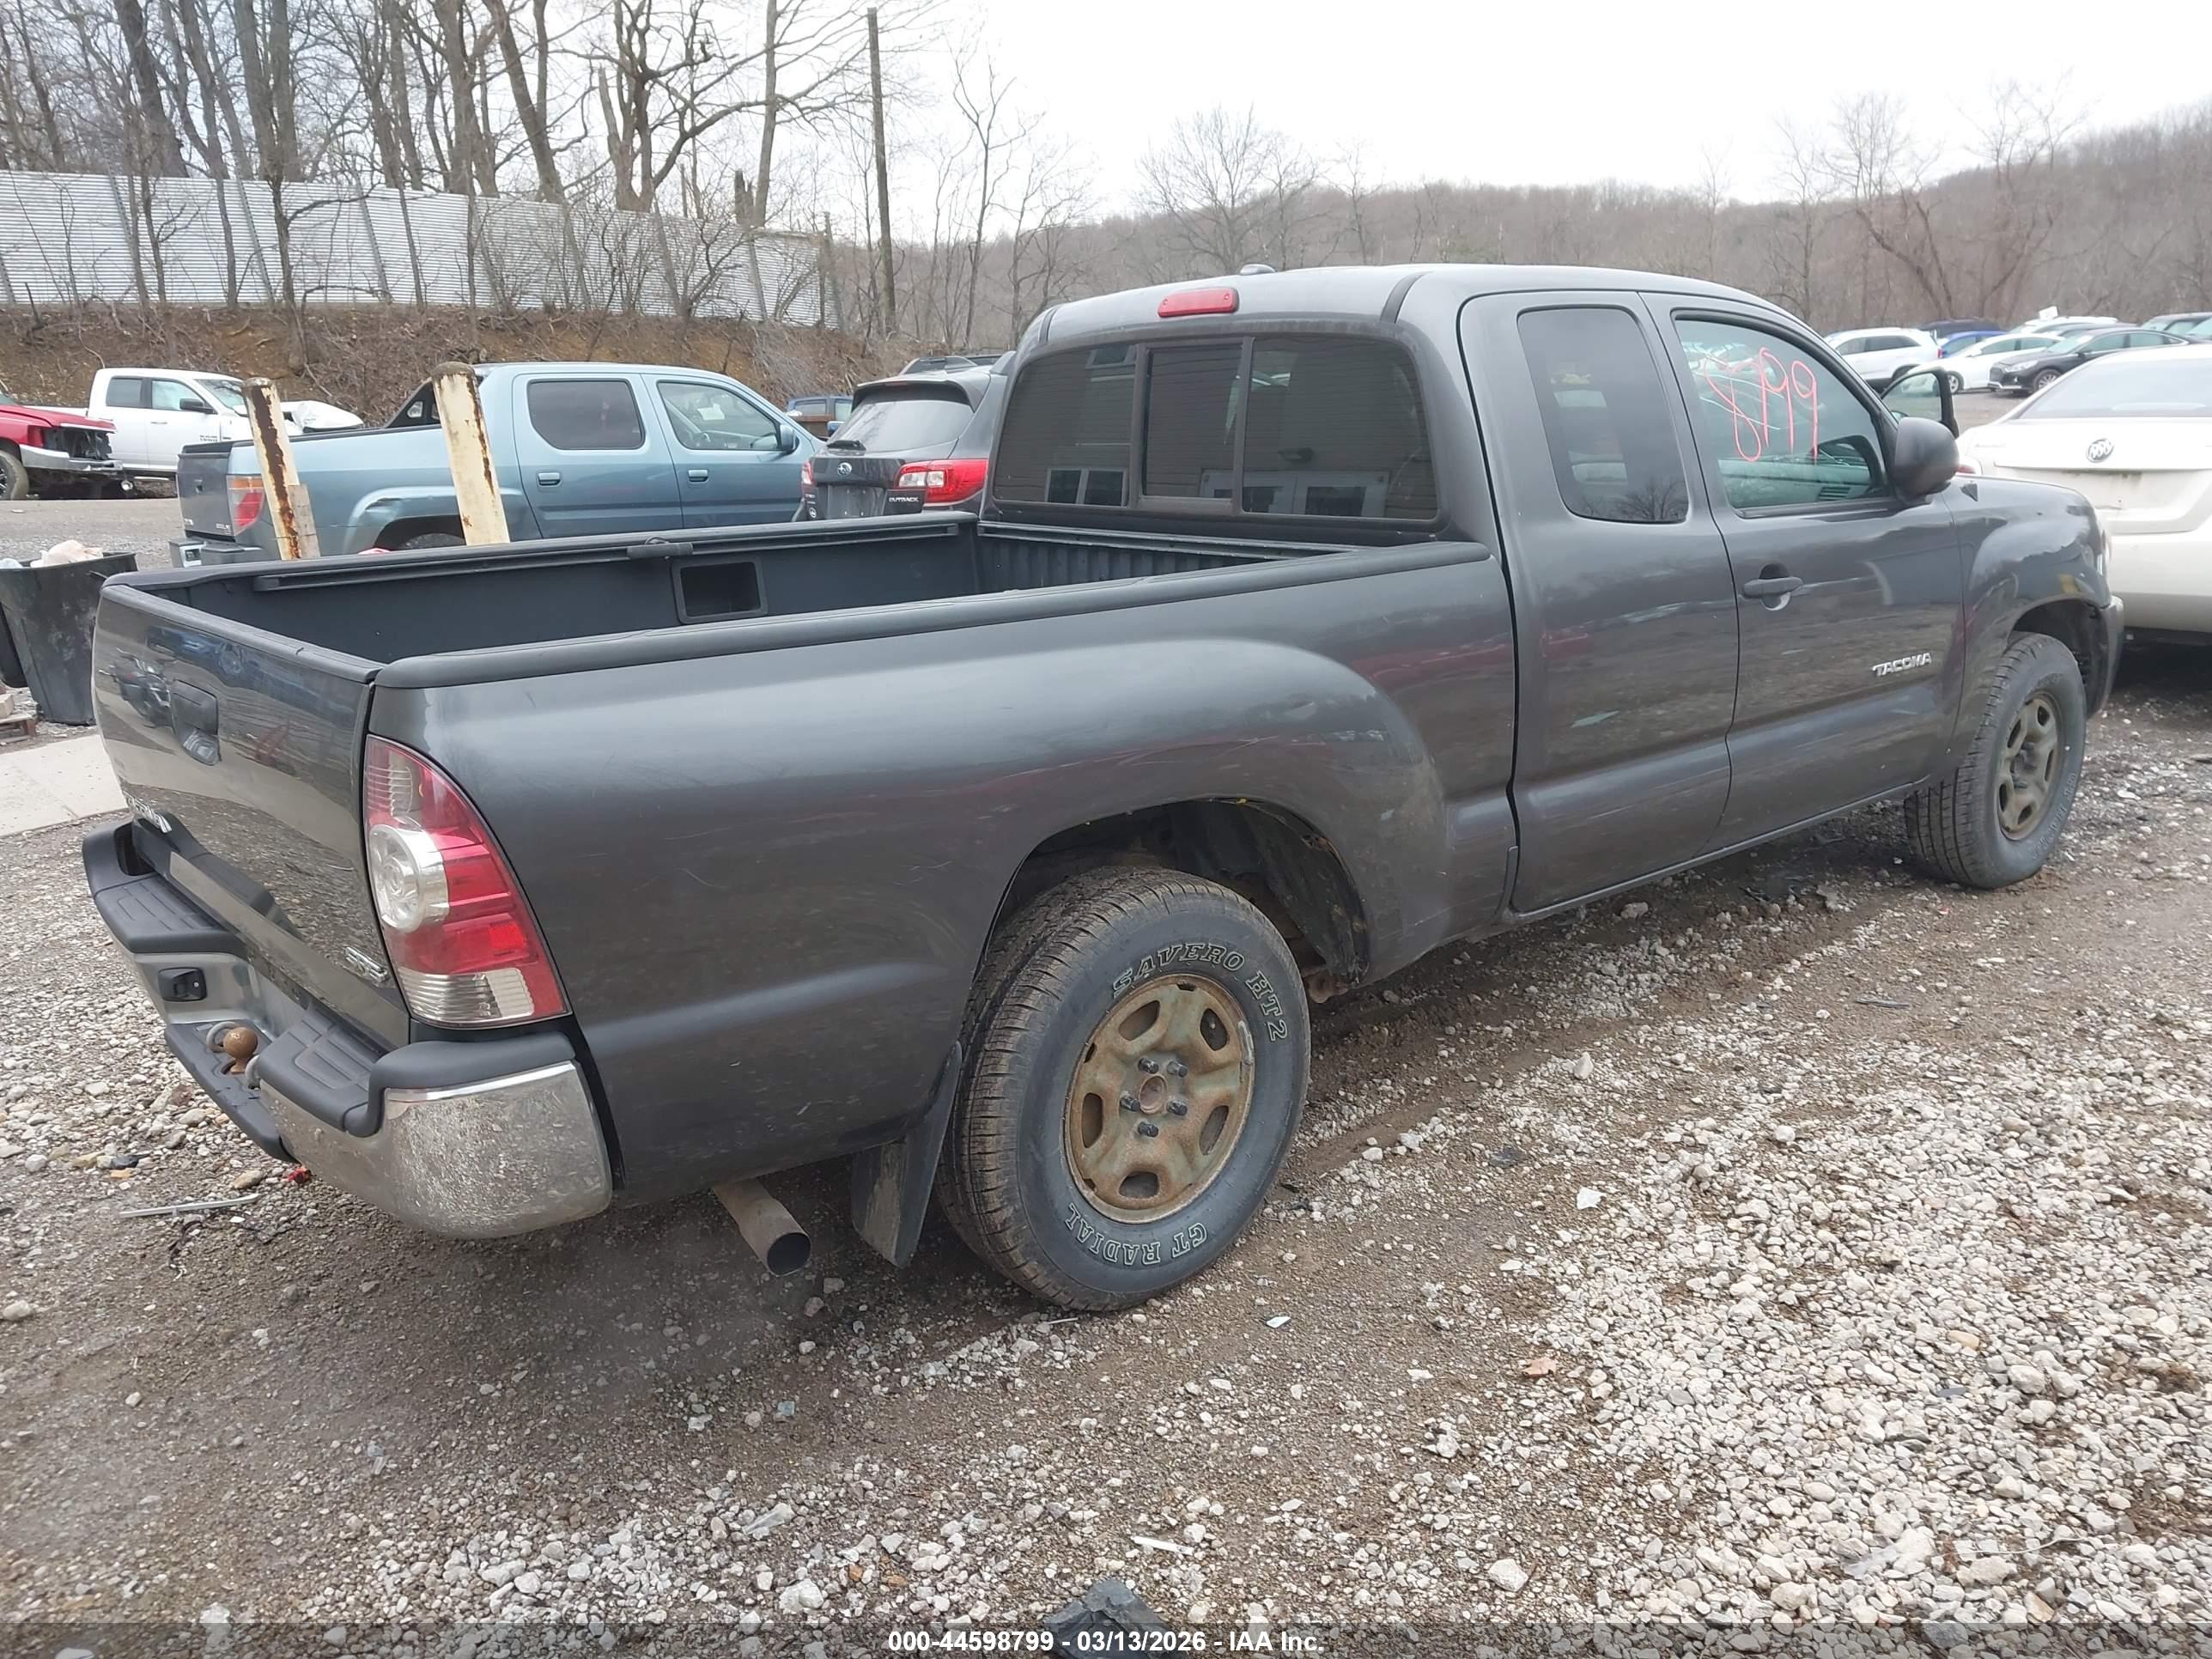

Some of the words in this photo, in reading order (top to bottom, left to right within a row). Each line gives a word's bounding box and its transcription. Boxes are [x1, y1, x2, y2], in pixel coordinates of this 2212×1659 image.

[1872, 652, 1932, 677] TACOMA
[1112, 942, 1245, 1000] SAVERO
[1245, 969, 1288, 1042] HT2
[1064, 1202, 1162, 1267] RADIAL
[1171, 1221, 1208, 1260] GT
